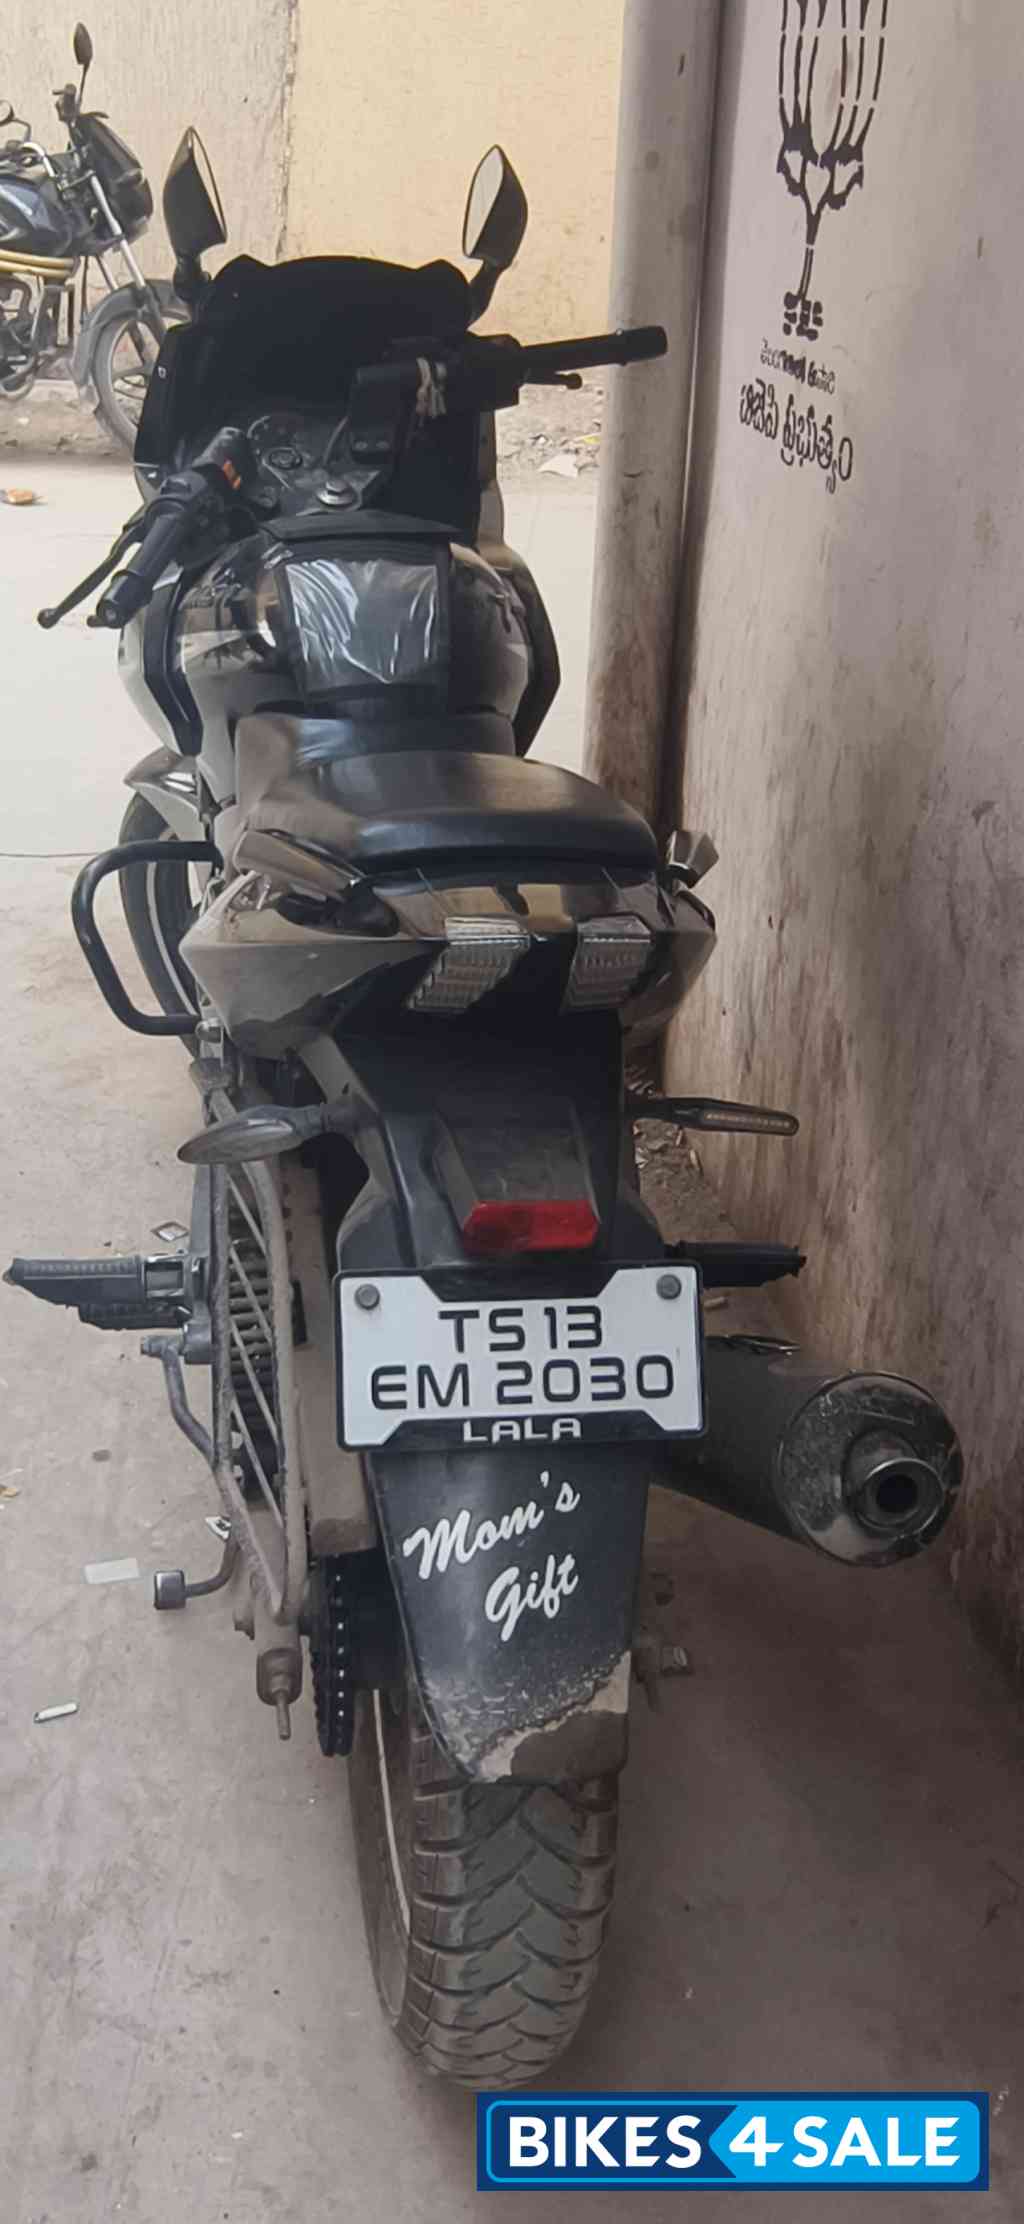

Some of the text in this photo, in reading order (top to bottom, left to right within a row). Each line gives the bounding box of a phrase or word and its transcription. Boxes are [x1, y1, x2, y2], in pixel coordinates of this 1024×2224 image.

[438, 1305, 603, 1353] TS 13
[370, 1355, 674, 1410] EM 2030
[463, 1417, 582, 1443] LALA
[402, 1470, 581, 1580] Mom's
[485, 1554, 579, 1642] Gift
